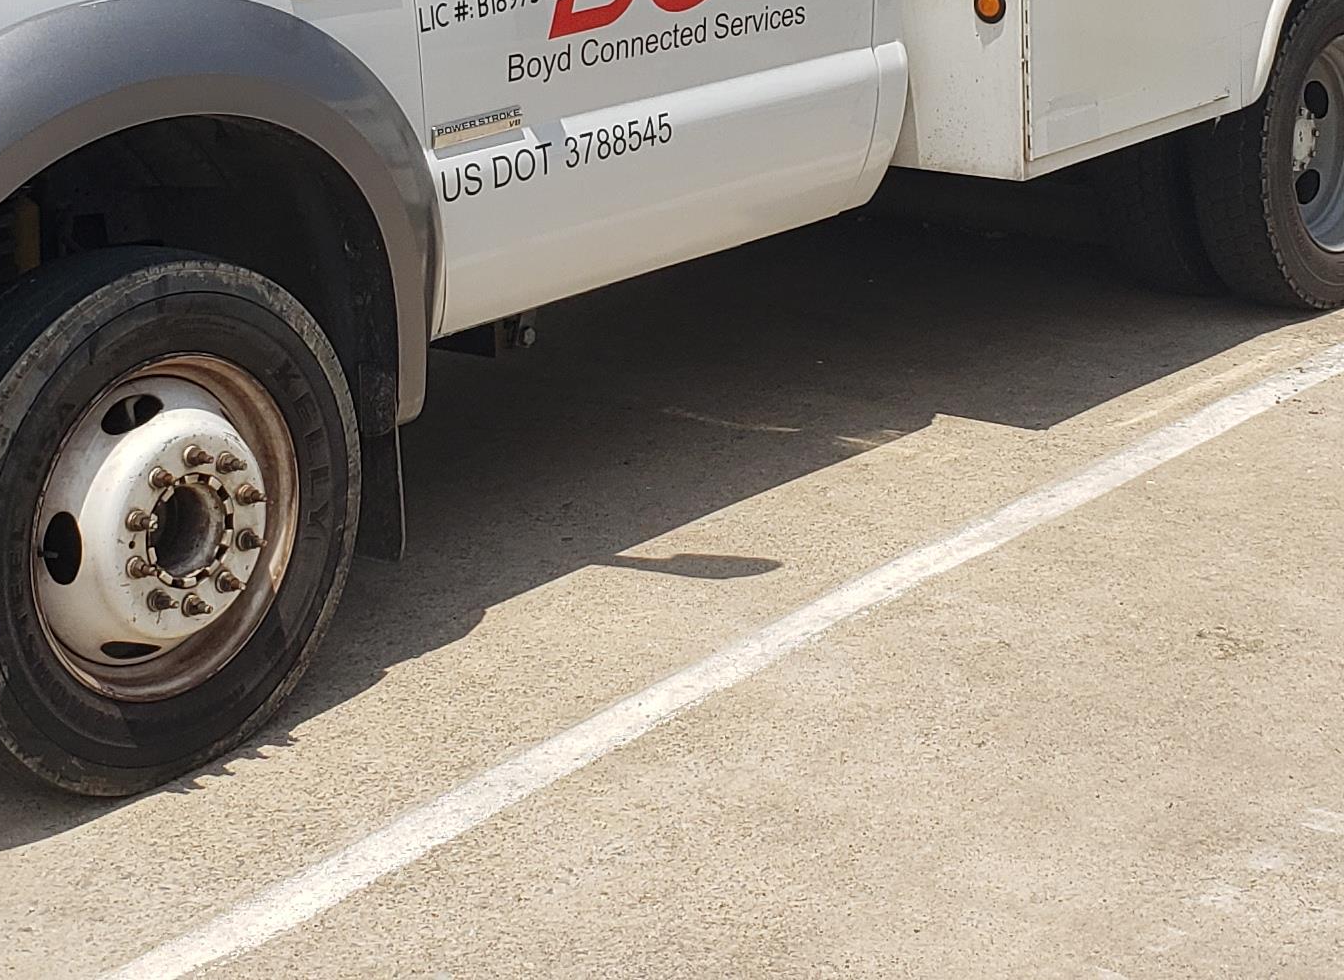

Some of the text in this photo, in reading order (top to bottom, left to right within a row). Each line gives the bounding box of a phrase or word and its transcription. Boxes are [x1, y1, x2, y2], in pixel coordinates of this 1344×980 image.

[418, 1, 451, 34] LIC
[507, 4, 807, 83] Boyd Connected Services
[440, 112, 673, 203] US DOT 3788545
